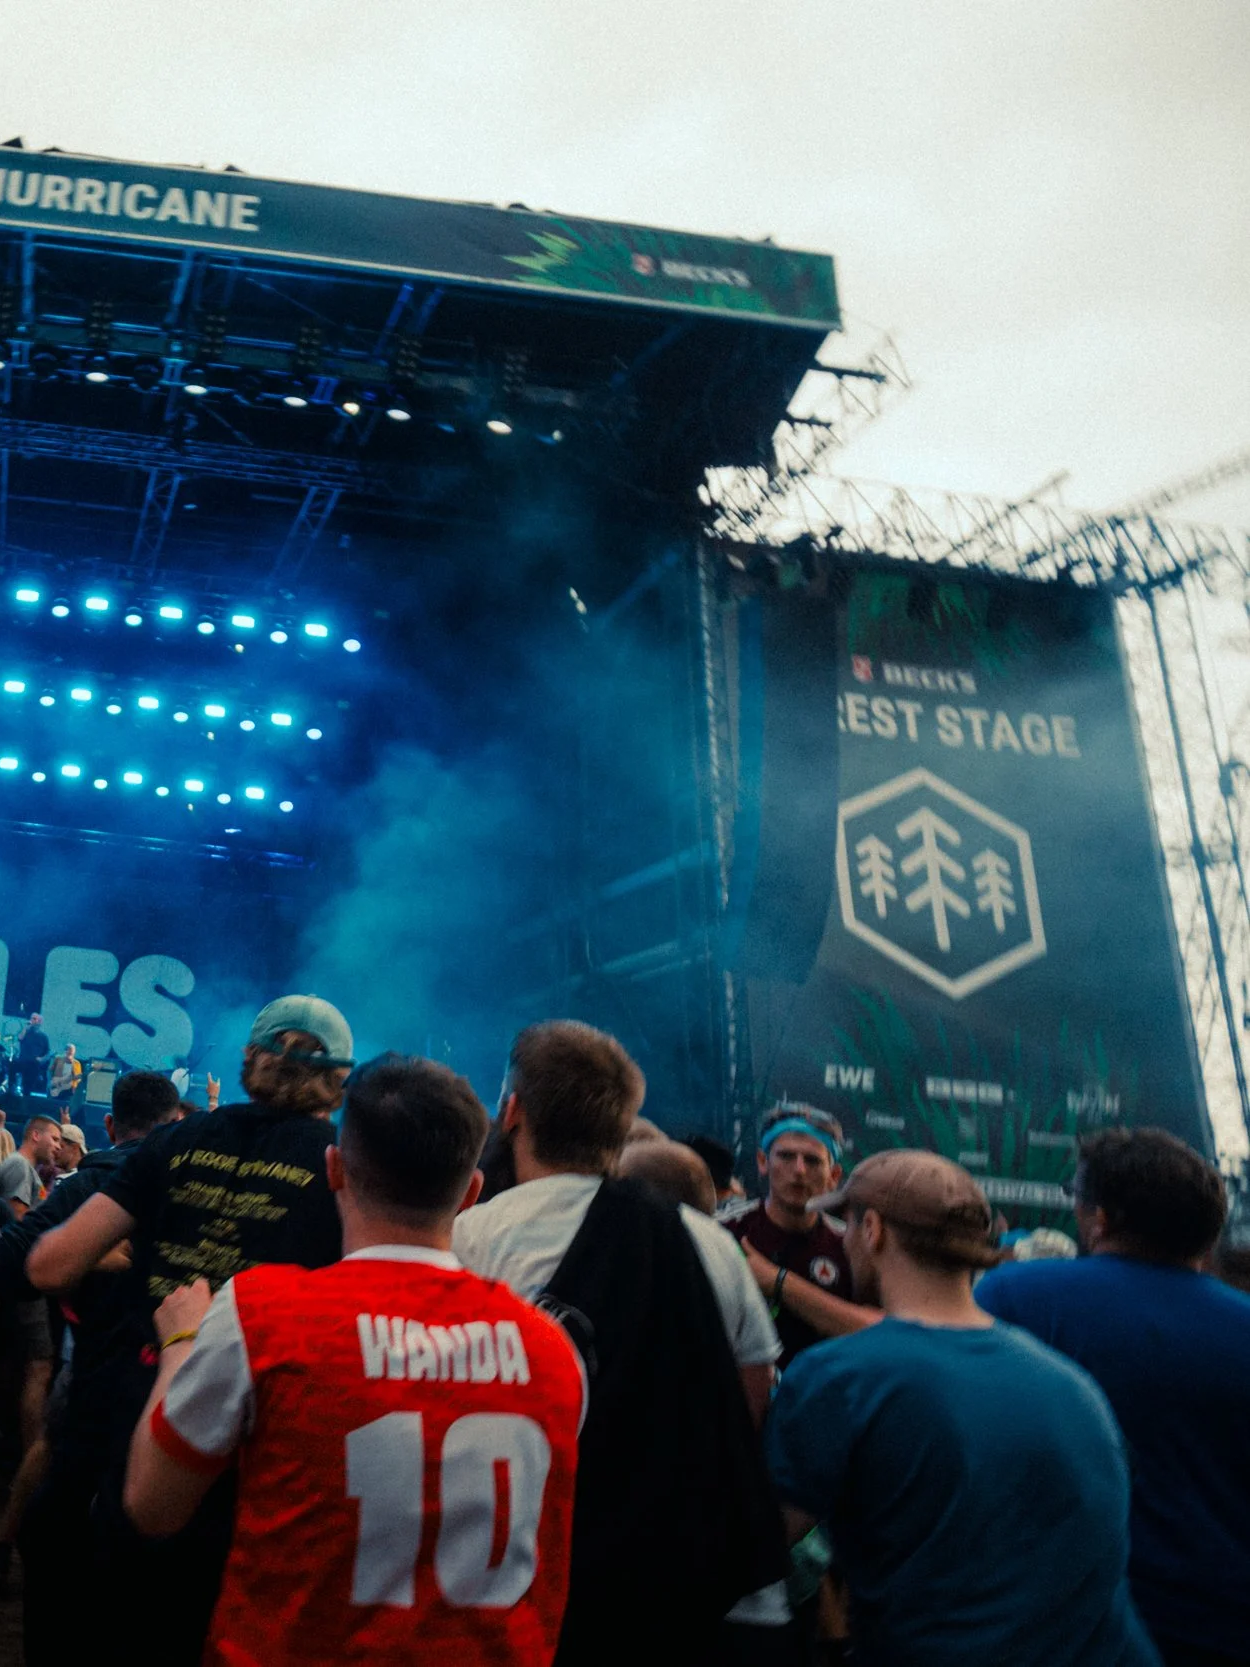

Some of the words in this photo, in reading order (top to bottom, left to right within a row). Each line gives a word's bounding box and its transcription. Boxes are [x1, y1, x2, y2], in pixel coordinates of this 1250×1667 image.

[934, 703, 1082, 758] STAGE
[823, 1062, 876, 1093] EWE
[355, 1312, 531, 1386] WANDA
[344, 1410, 552, 1609] 10
